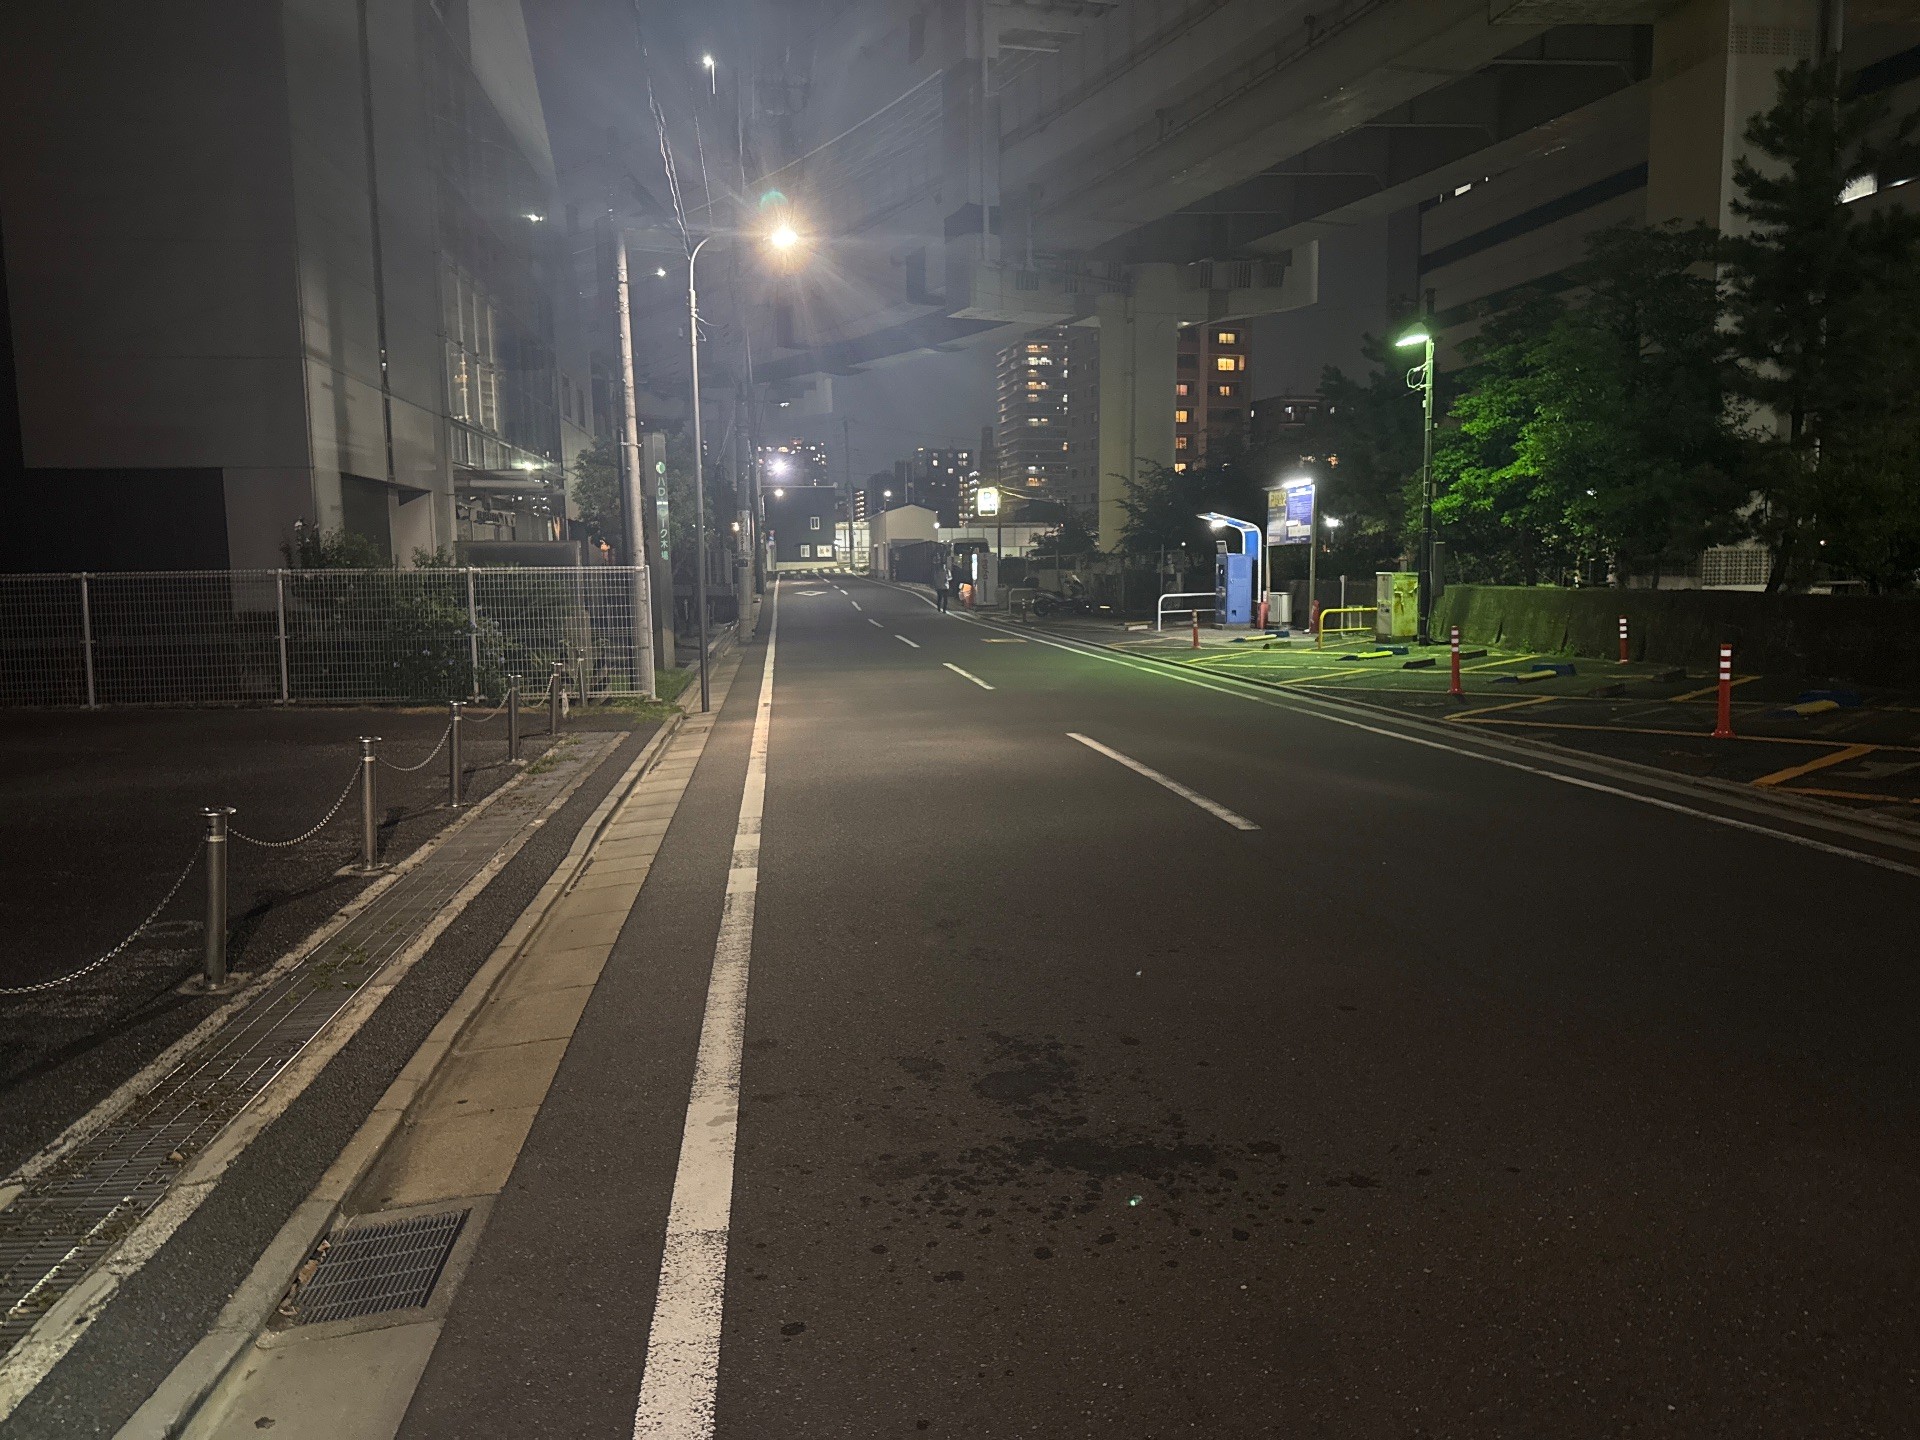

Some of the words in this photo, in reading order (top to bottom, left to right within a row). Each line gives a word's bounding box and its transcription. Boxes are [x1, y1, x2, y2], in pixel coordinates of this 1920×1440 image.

[657, 477, 669, 561] ハローク木場
